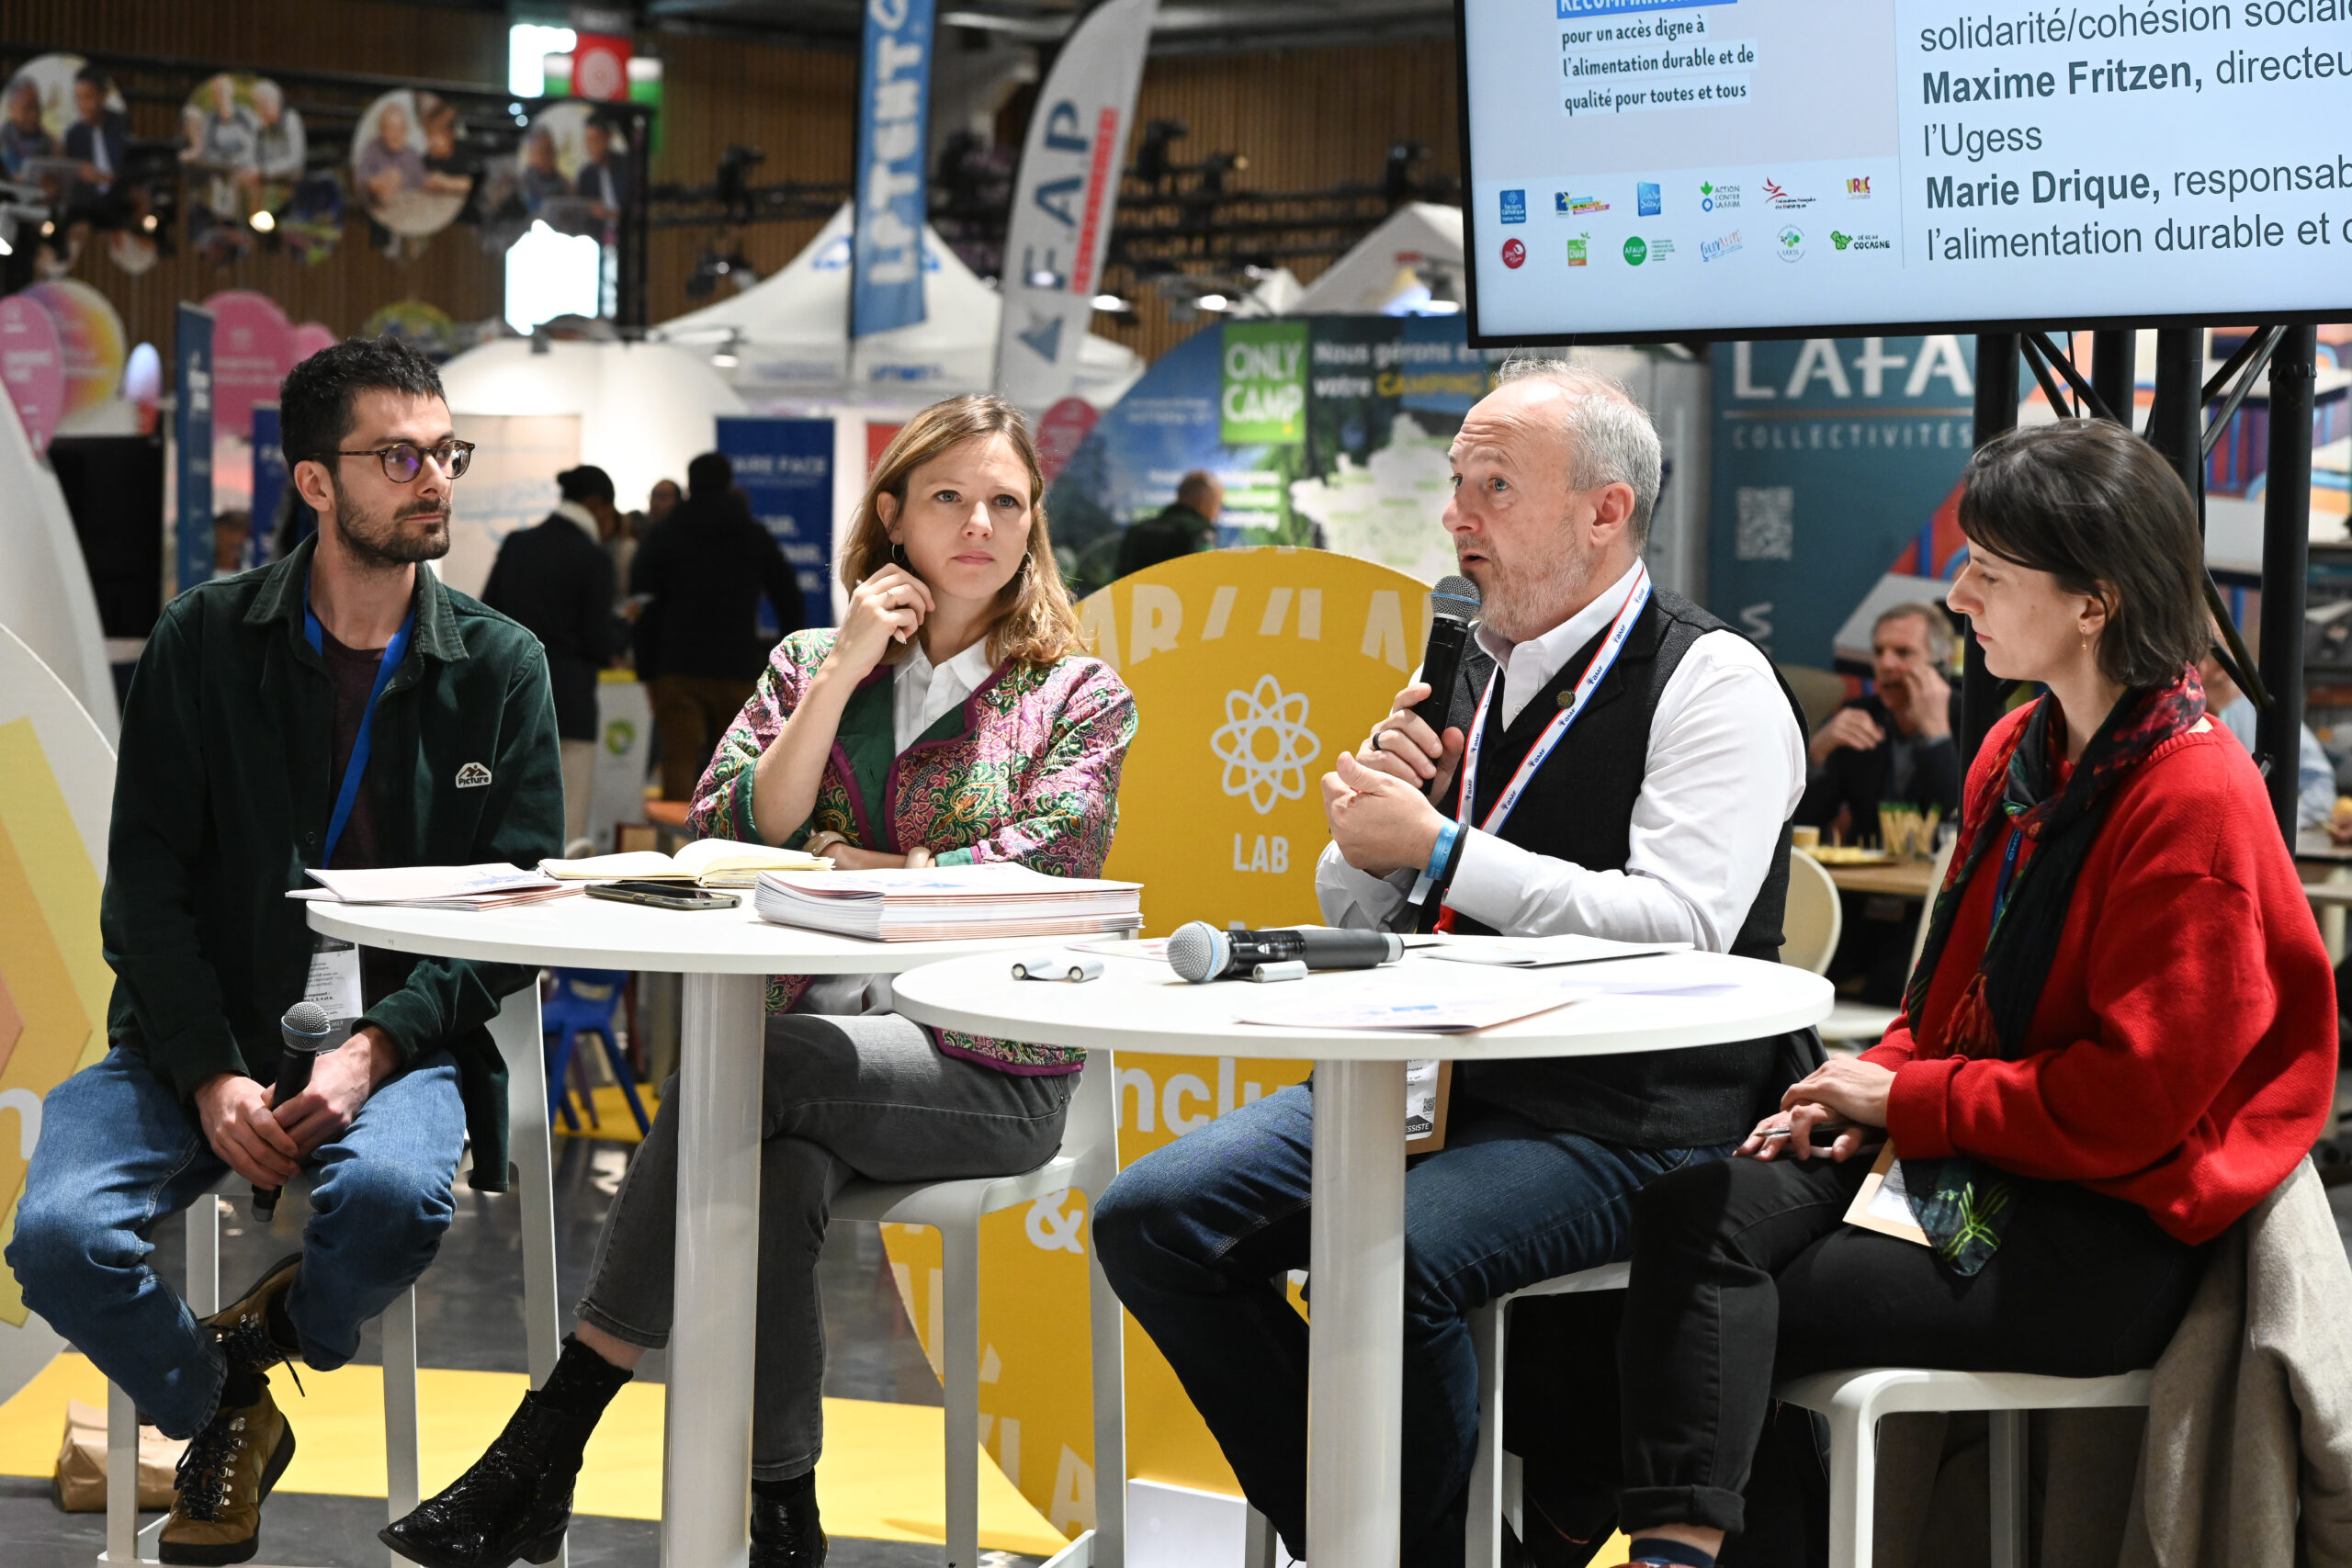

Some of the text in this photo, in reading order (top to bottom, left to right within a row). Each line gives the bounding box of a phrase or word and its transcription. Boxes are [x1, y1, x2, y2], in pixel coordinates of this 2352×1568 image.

[1562, 14, 1705, 51] pour un accès digne à
[1920, 0, 2352, 52] solidarité/cohésion social
[1662, 47, 1715, 70] durable
[1719, 50, 1734, 64] et
[1736, 44, 1754, 63] de
[1565, 84, 1747, 117] qualité pour toutes et tous
[1923, 68, 2055, 105] Maxime
[2068, 58, 2202, 94] Fritzen,
[1927, 175, 2019, 209] Marie
[2032, 169, 2160, 209] Drique,
[2154, 214, 2283, 252] durable
[2297, 212, 2331, 246] et
[1225, 341, 1303, 380] ONLY
[458, 775, 489, 786] Picture
[1233, 833, 1289, 874] LAB
